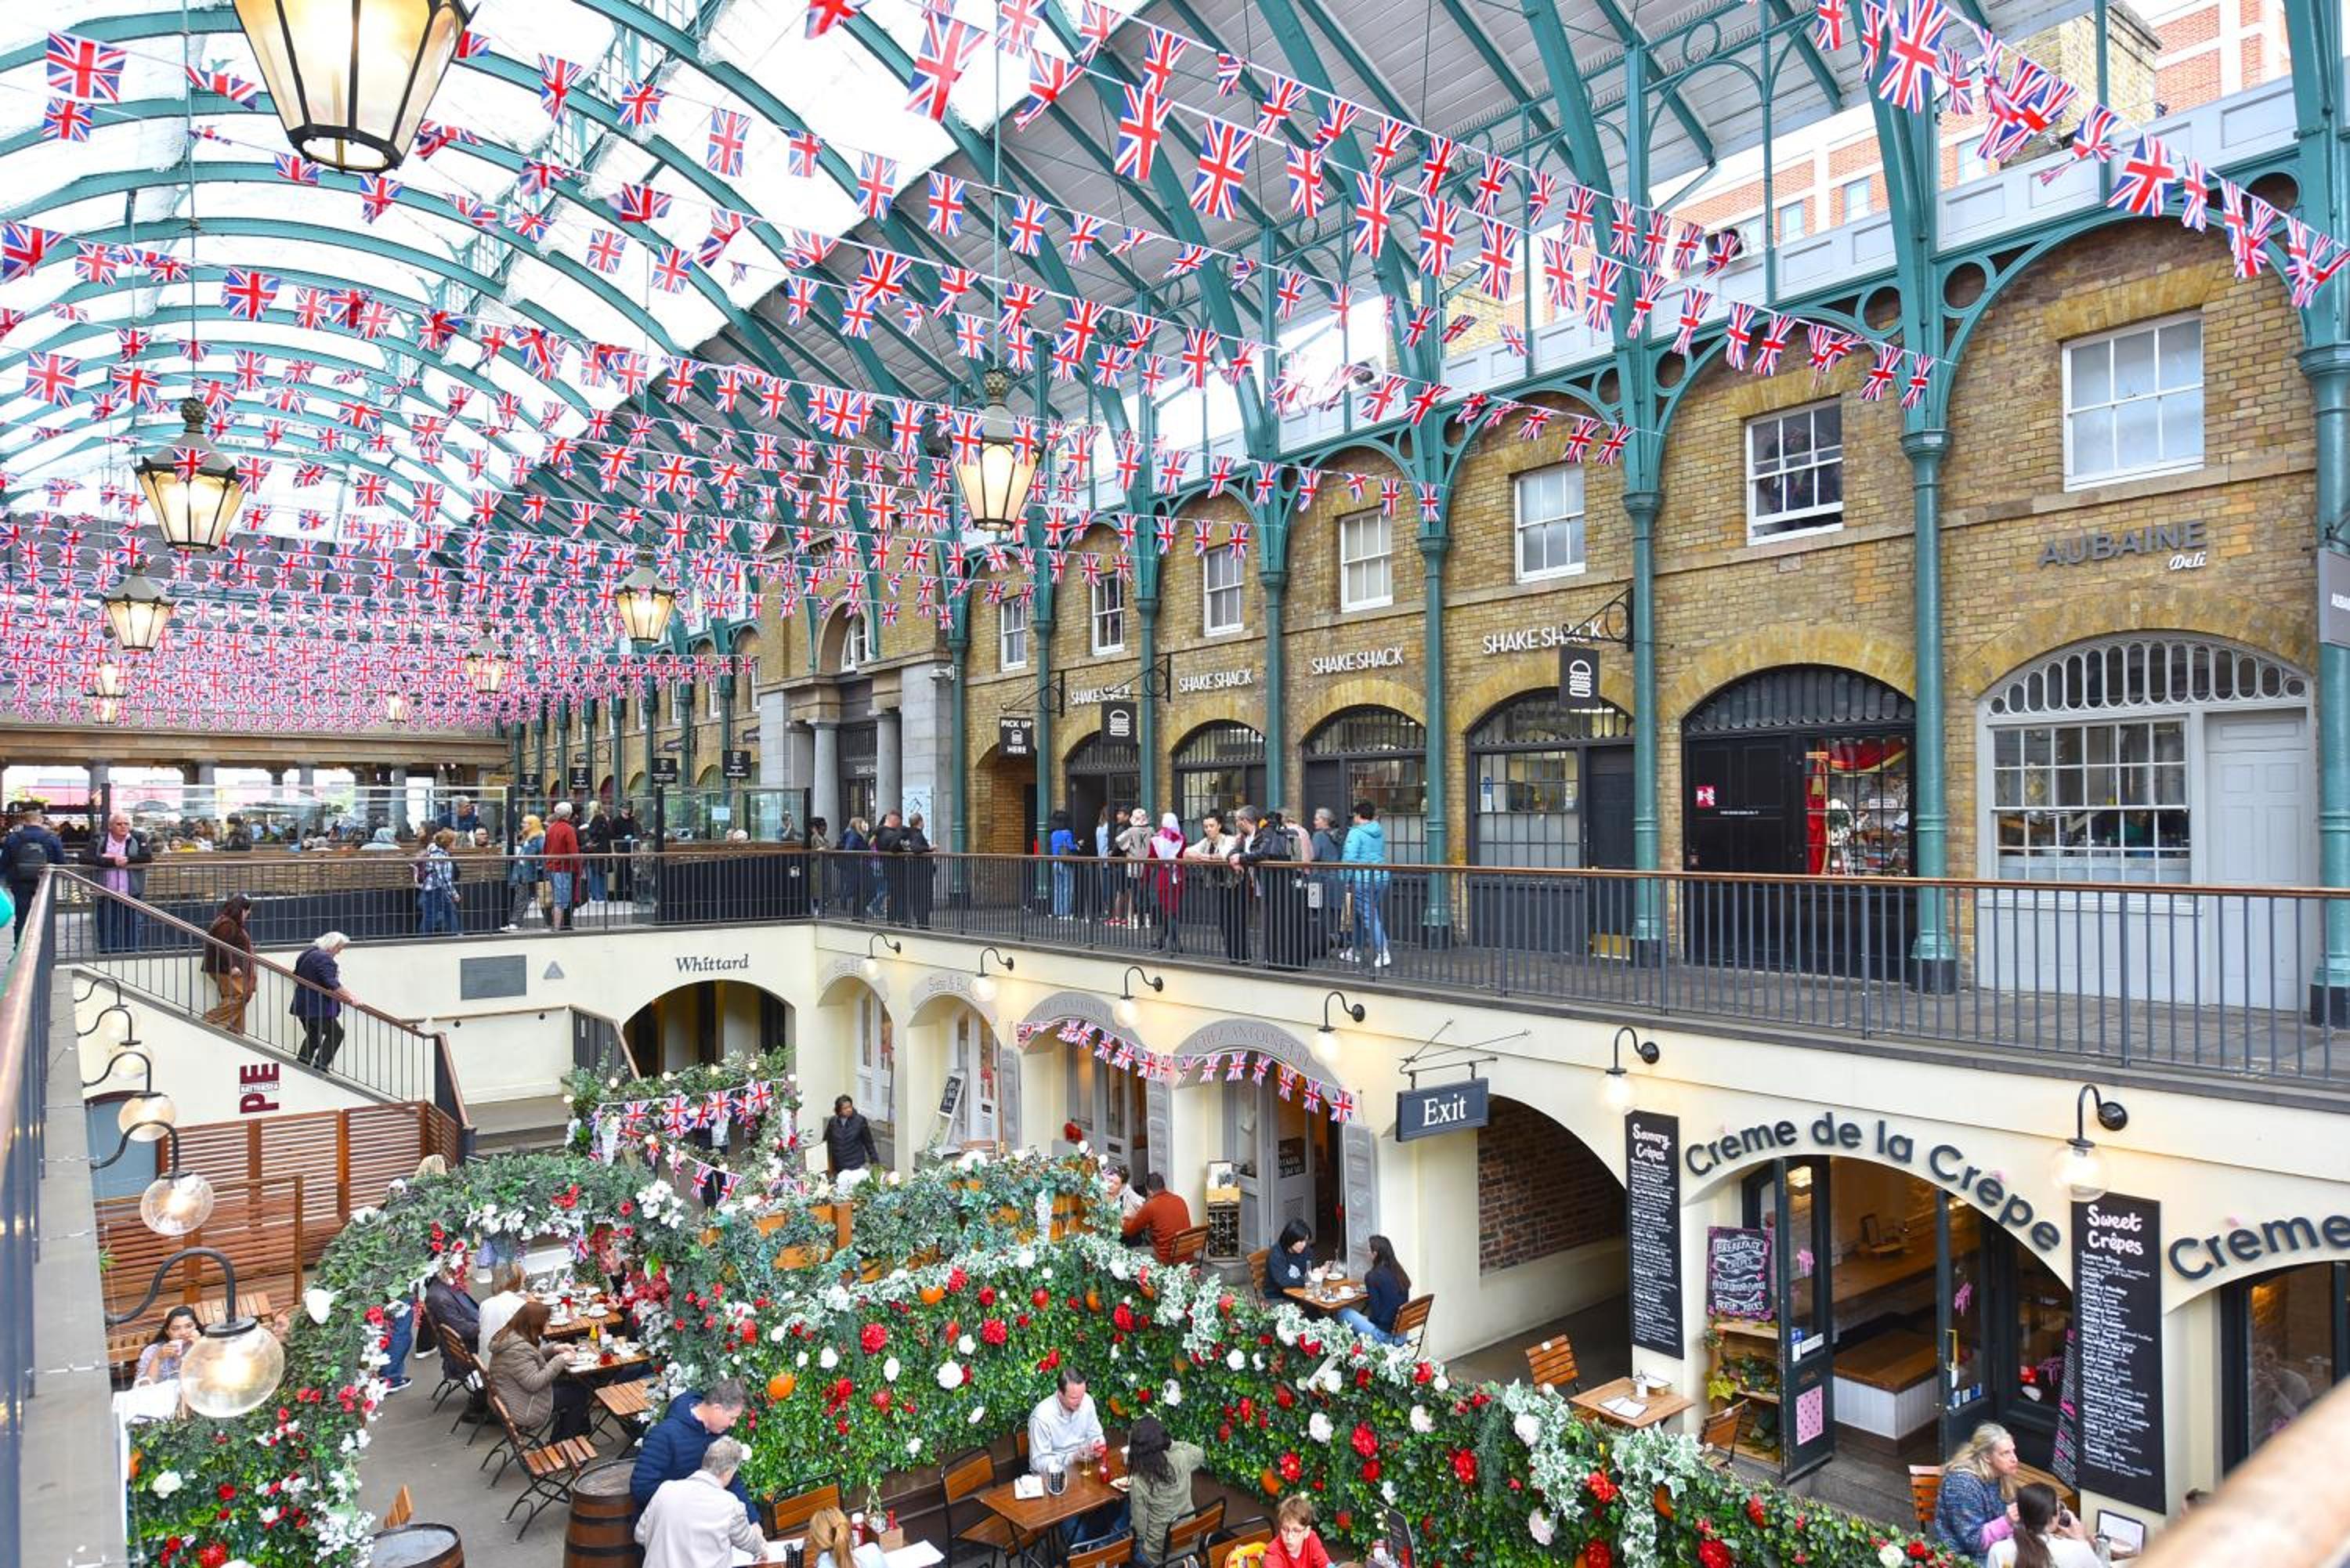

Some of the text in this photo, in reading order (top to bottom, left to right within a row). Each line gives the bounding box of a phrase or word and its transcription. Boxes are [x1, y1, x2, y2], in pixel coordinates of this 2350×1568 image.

[2038, 519, 2207, 569] AUBAINE
[2168, 551, 2207, 570] Deli
[1483, 629, 1540, 654] SHAKE
[1312, 646, 1404, 675] SHAKE SHACK
[1179, 668, 1253, 693] SHAKE SHACK
[1021, 720, 1032, 728] UP
[1007, 745, 1027, 754] HERE
[676, 953, 749, 971] Whittard
[1423, 1093, 1467, 1126] Exit
[1811, 1111, 1862, 1149] de
[1878, 1120, 1914, 1164] la
[2087, 1204, 2143, 1232] Sweet
[2088, 1230, 2144, 1255] Crêpes
